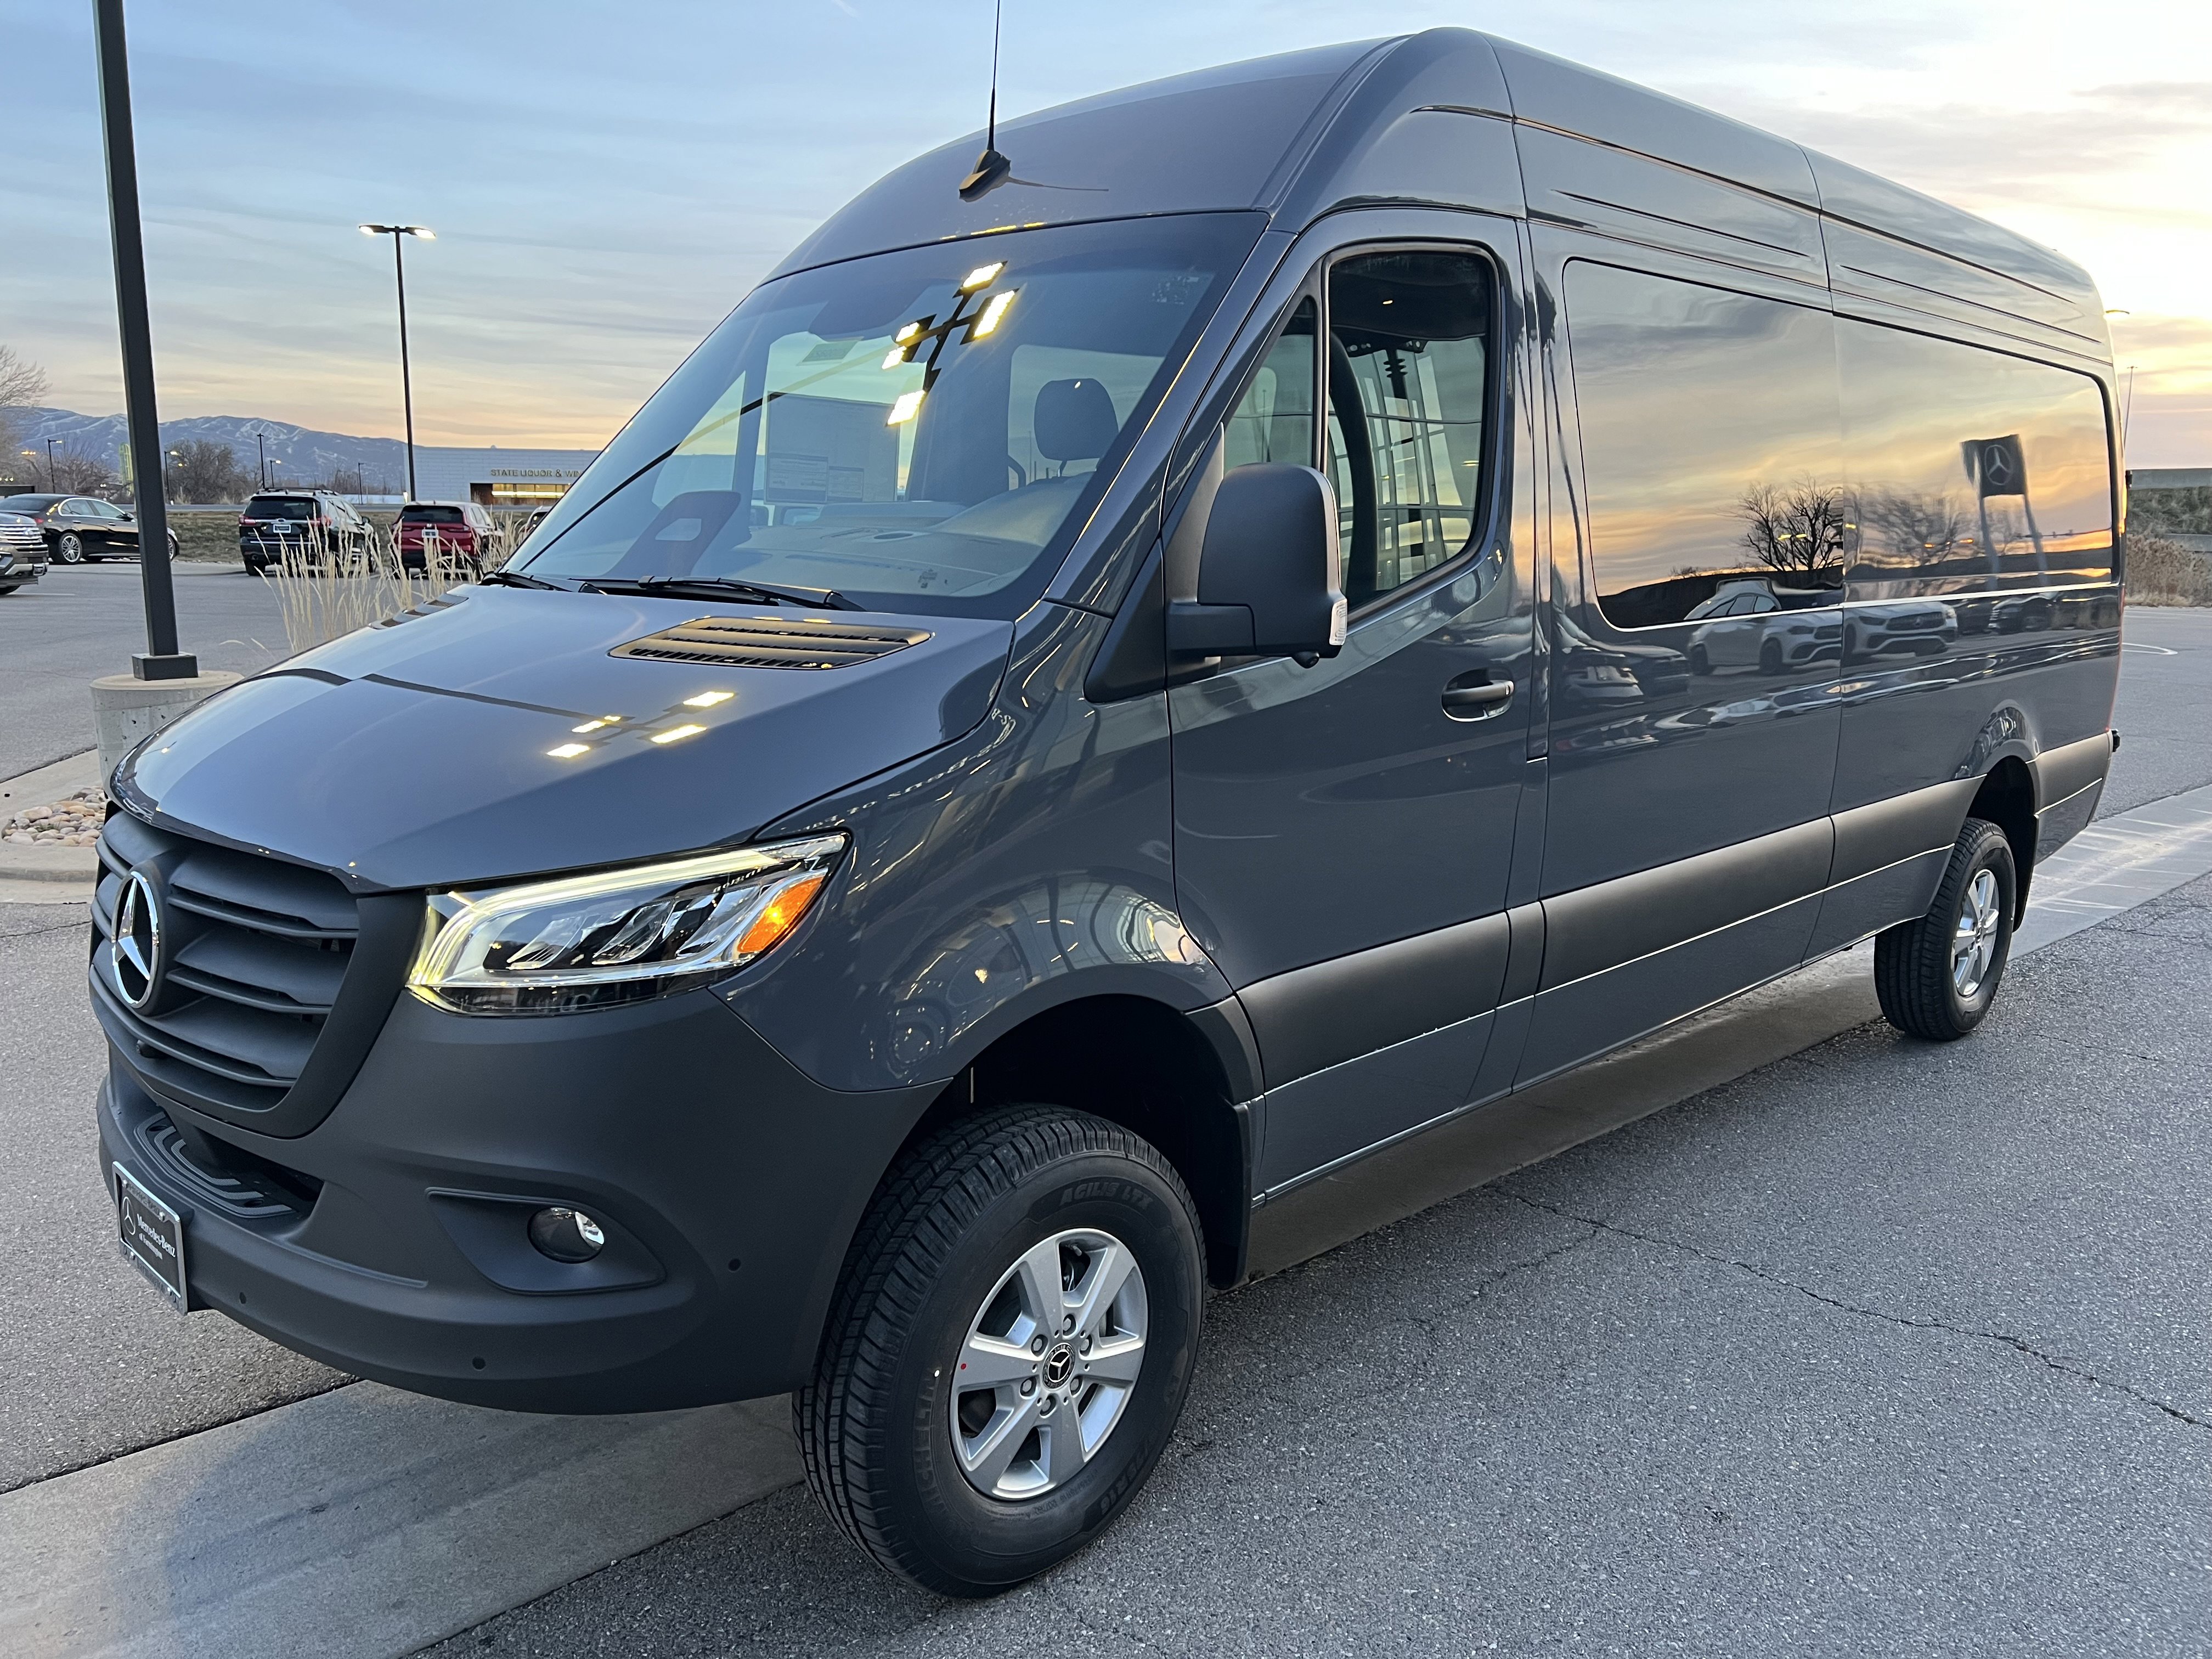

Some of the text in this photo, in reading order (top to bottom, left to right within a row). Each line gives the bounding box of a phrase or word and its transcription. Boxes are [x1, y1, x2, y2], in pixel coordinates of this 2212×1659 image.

[555, 469, 562, 477] &
[1059, 1182, 1154, 1211] AGILIS LTX
[137, 1213, 176, 1258] Mercedes-Benz
